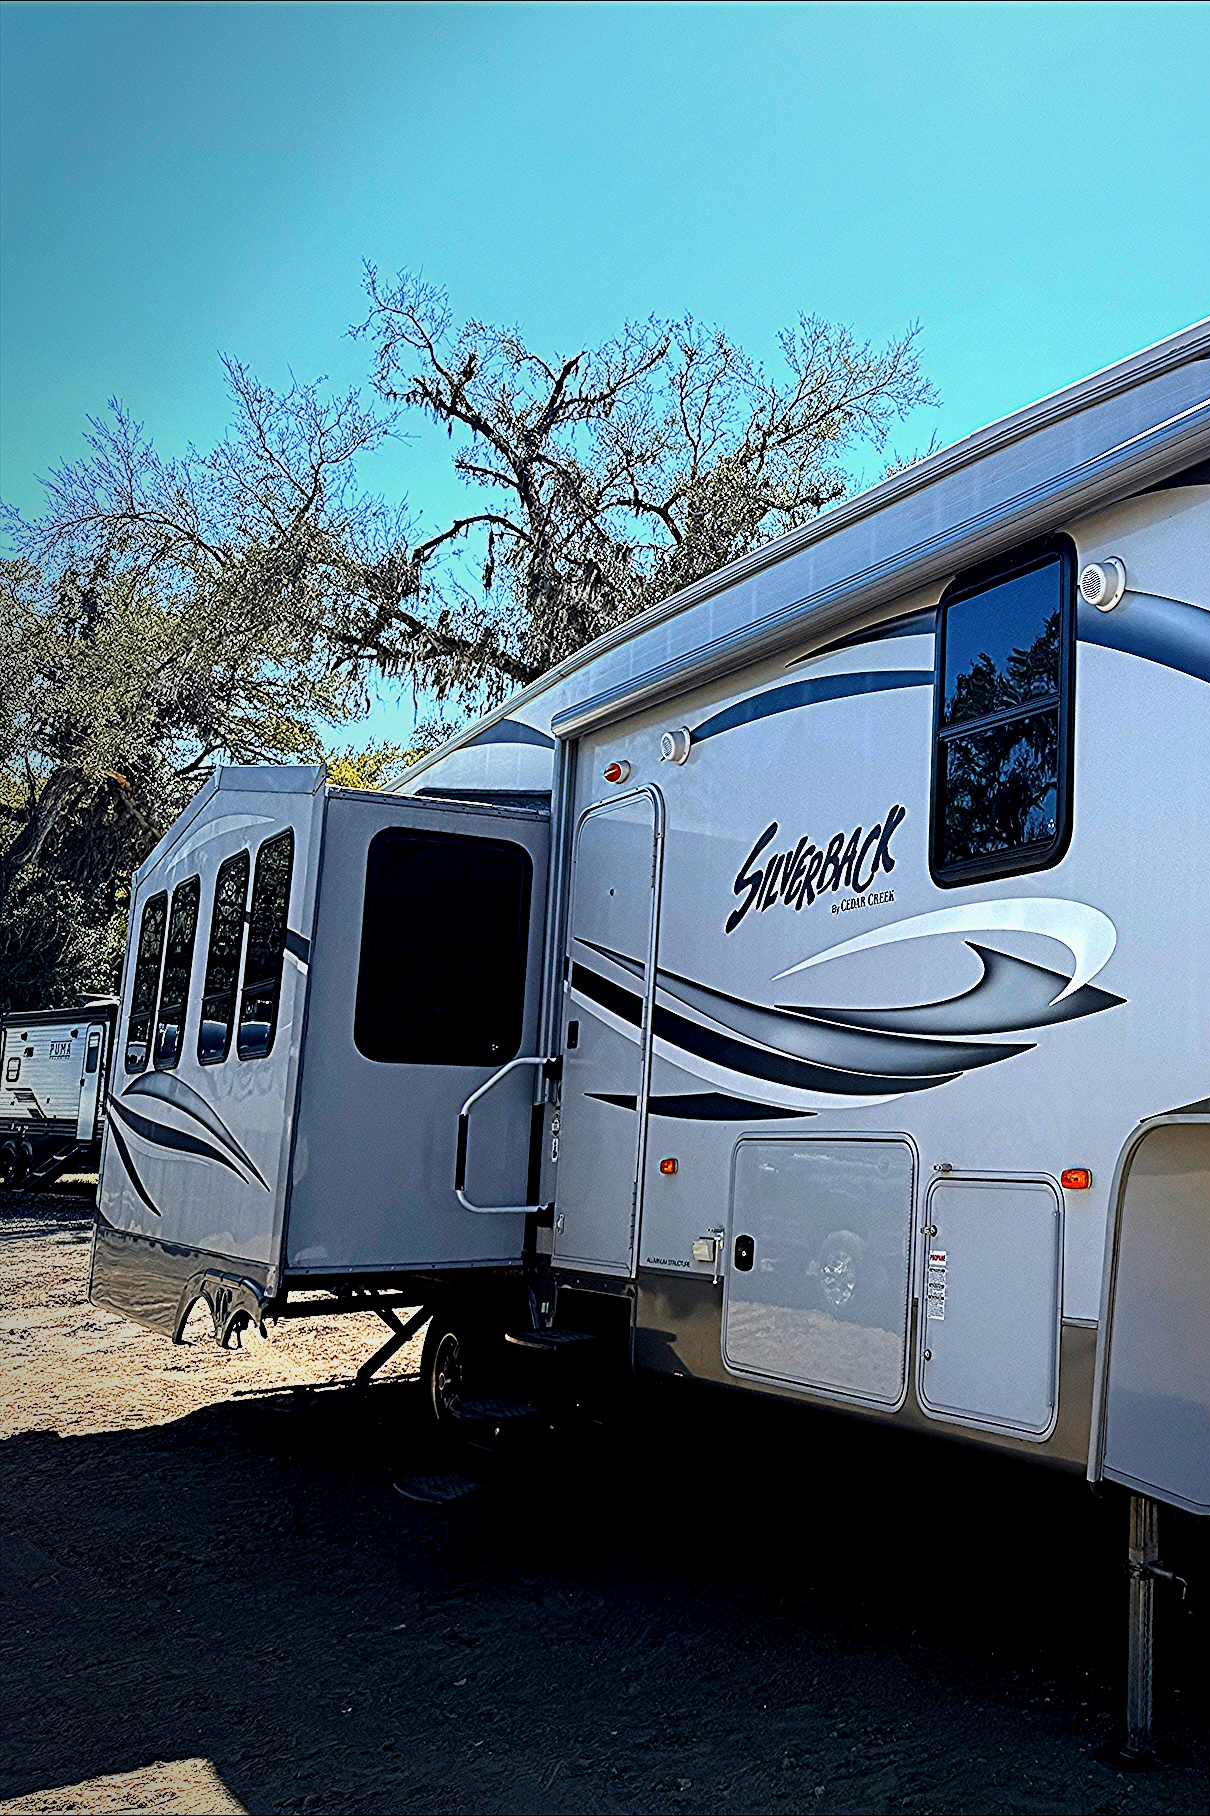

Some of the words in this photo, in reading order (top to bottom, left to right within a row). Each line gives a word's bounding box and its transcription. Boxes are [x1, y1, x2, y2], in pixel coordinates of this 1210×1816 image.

[725, 804, 906, 935] SILVERBACK
[831, 904, 840, 915] By
[840, 896, 866, 912] CEDAR
[867, 889, 895, 906] CREEK
[49, 1042, 71, 1055] PUMA
